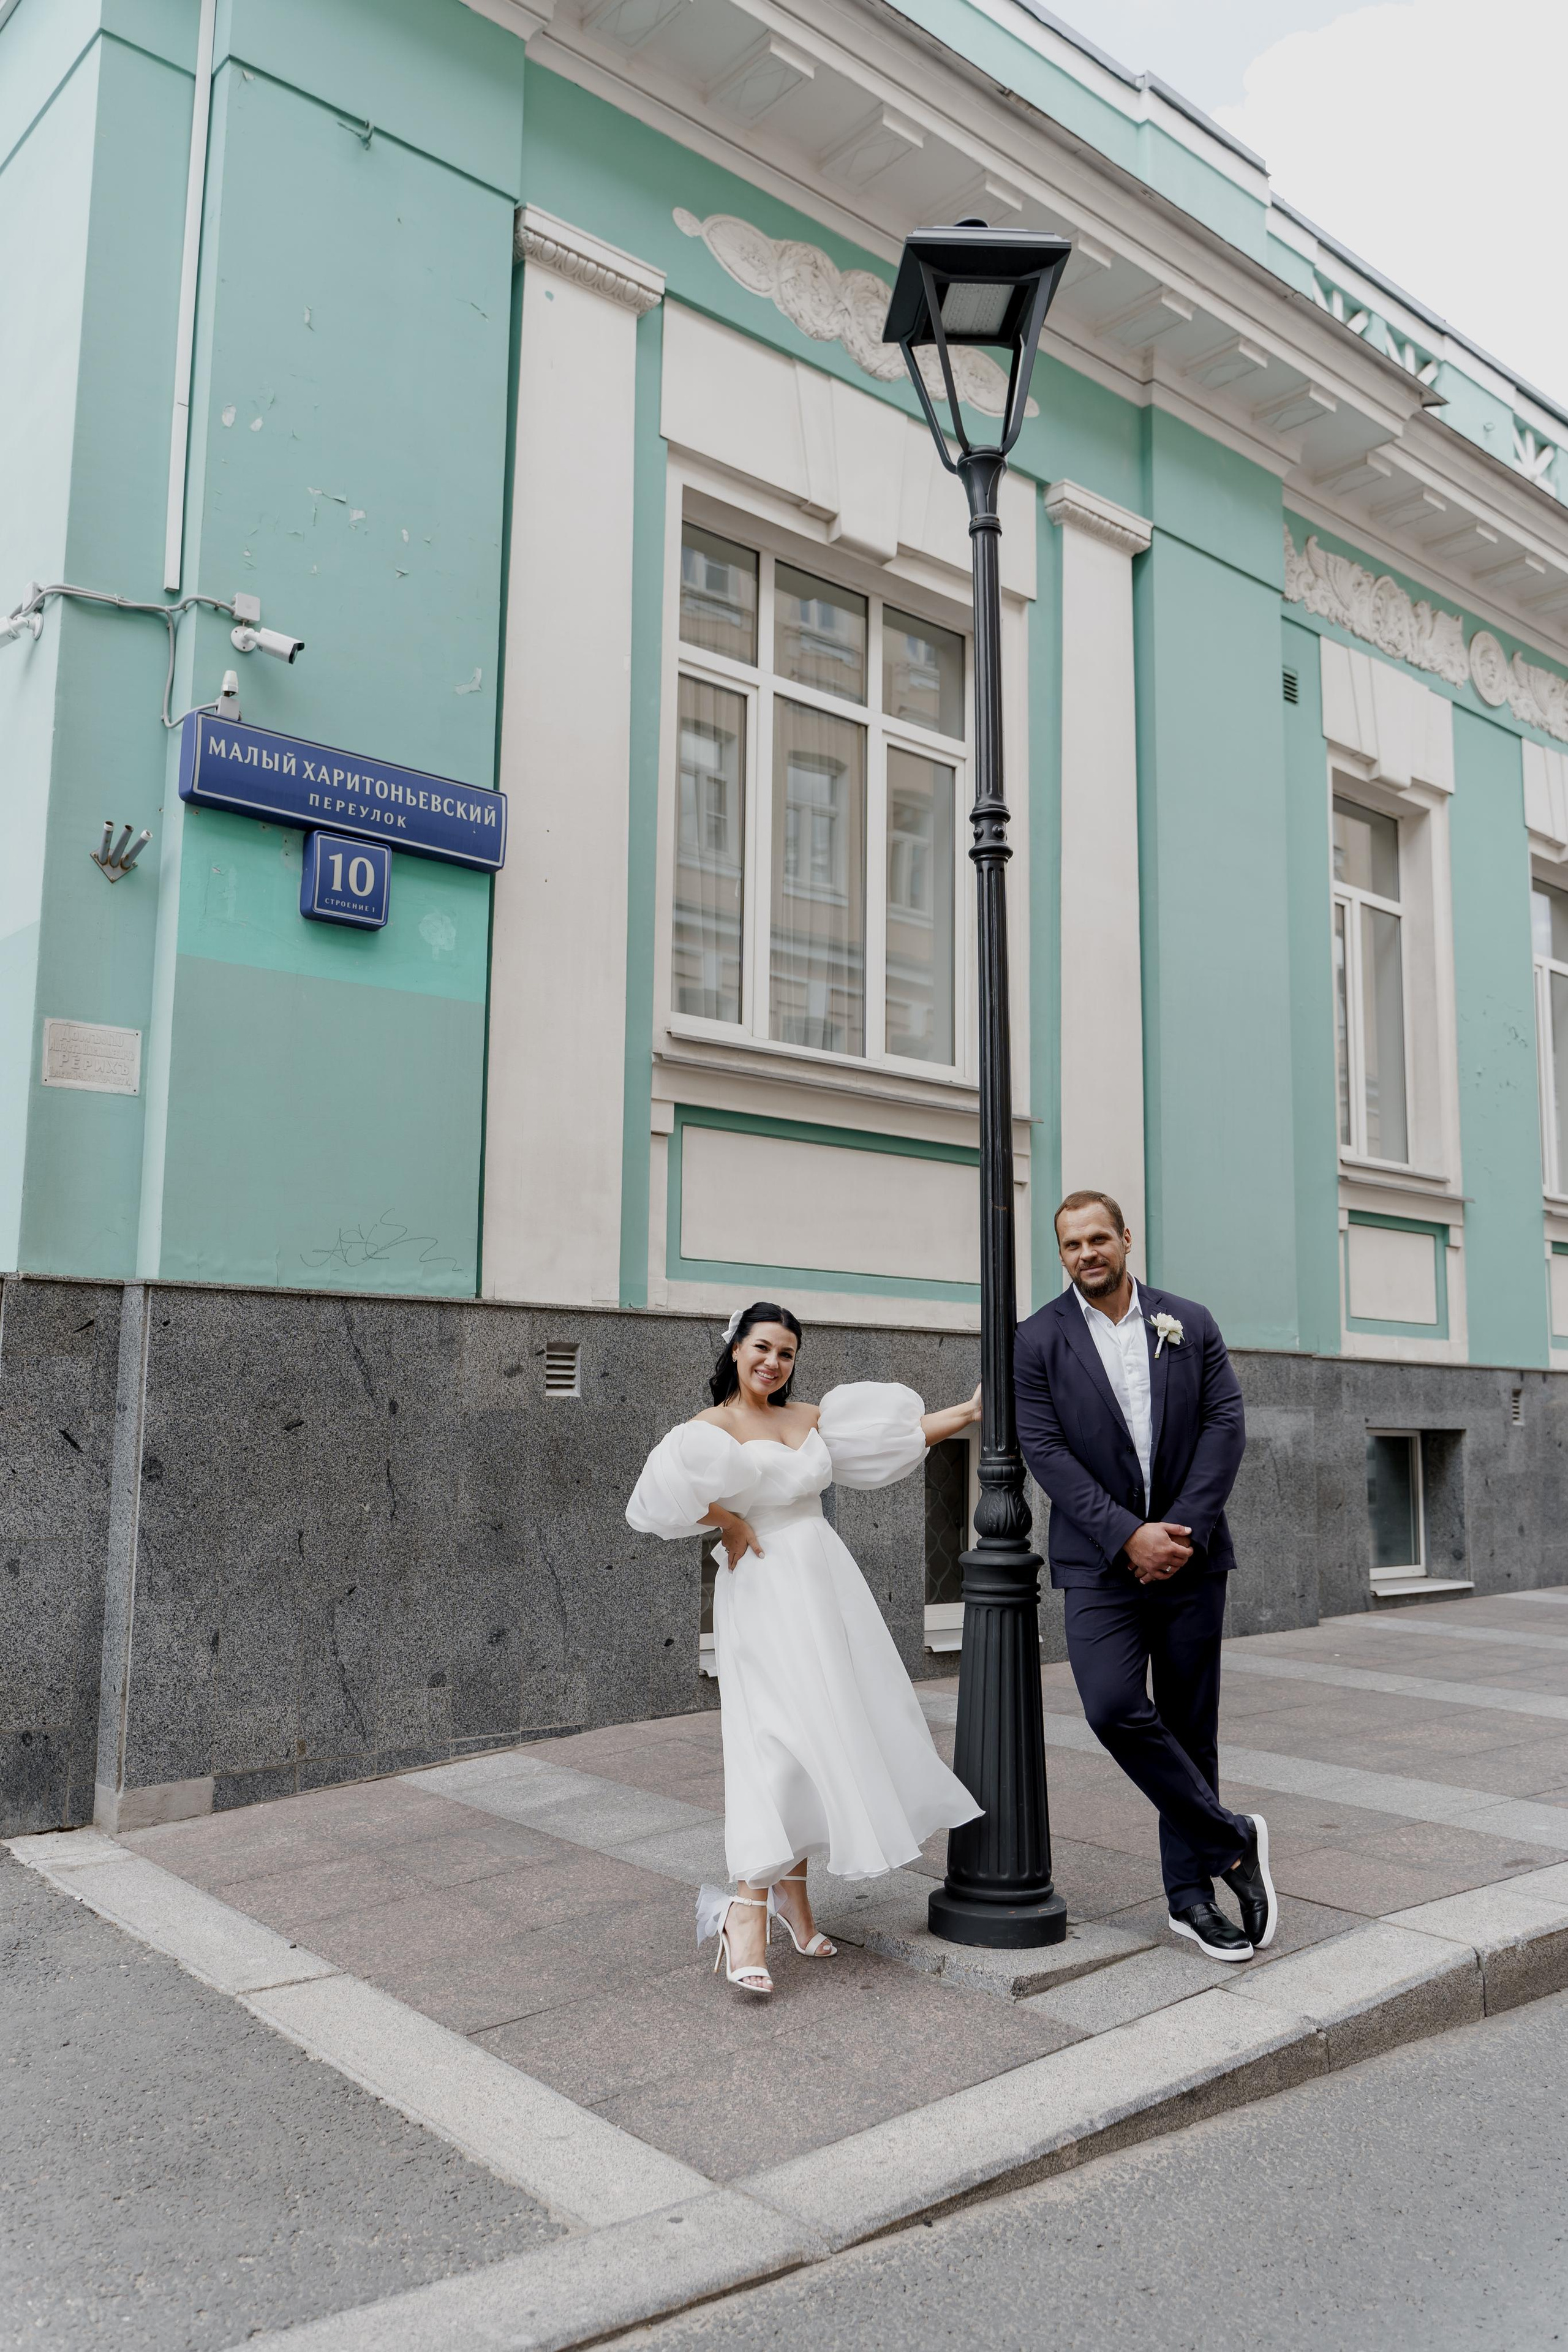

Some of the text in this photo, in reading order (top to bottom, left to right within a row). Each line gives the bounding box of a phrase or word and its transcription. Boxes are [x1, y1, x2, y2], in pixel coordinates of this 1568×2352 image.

[208, 736, 496, 827] МАЛЫЙ ХАРИТОНЬЕВСКИЙ
[309, 793, 406, 828] ПЕРЕУЛОК
[329, 853, 375, 897] 10
[325, 897, 369, 912] СТРОЕНИЕ
